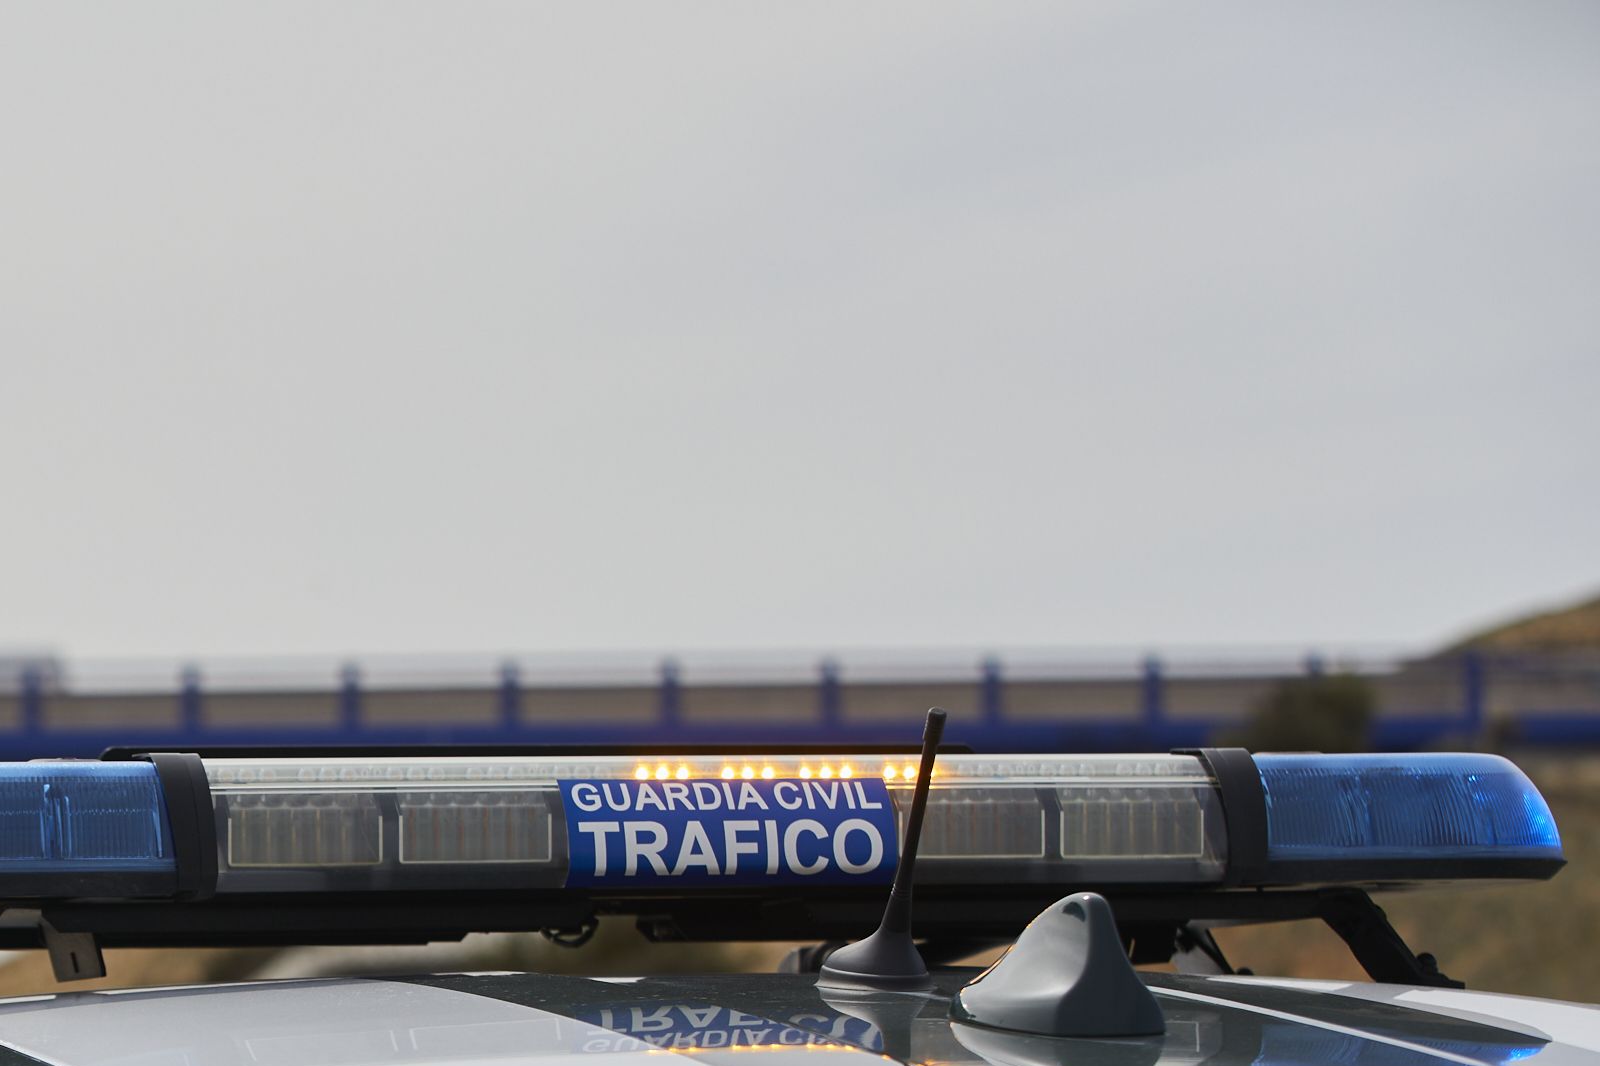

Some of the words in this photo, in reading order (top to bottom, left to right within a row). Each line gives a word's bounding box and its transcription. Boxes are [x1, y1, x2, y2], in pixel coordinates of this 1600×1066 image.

[571, 782, 769, 812] GUARDIA
[773, 781, 883, 811] CIVIL
[578, 818, 884, 877] TRAFICO
